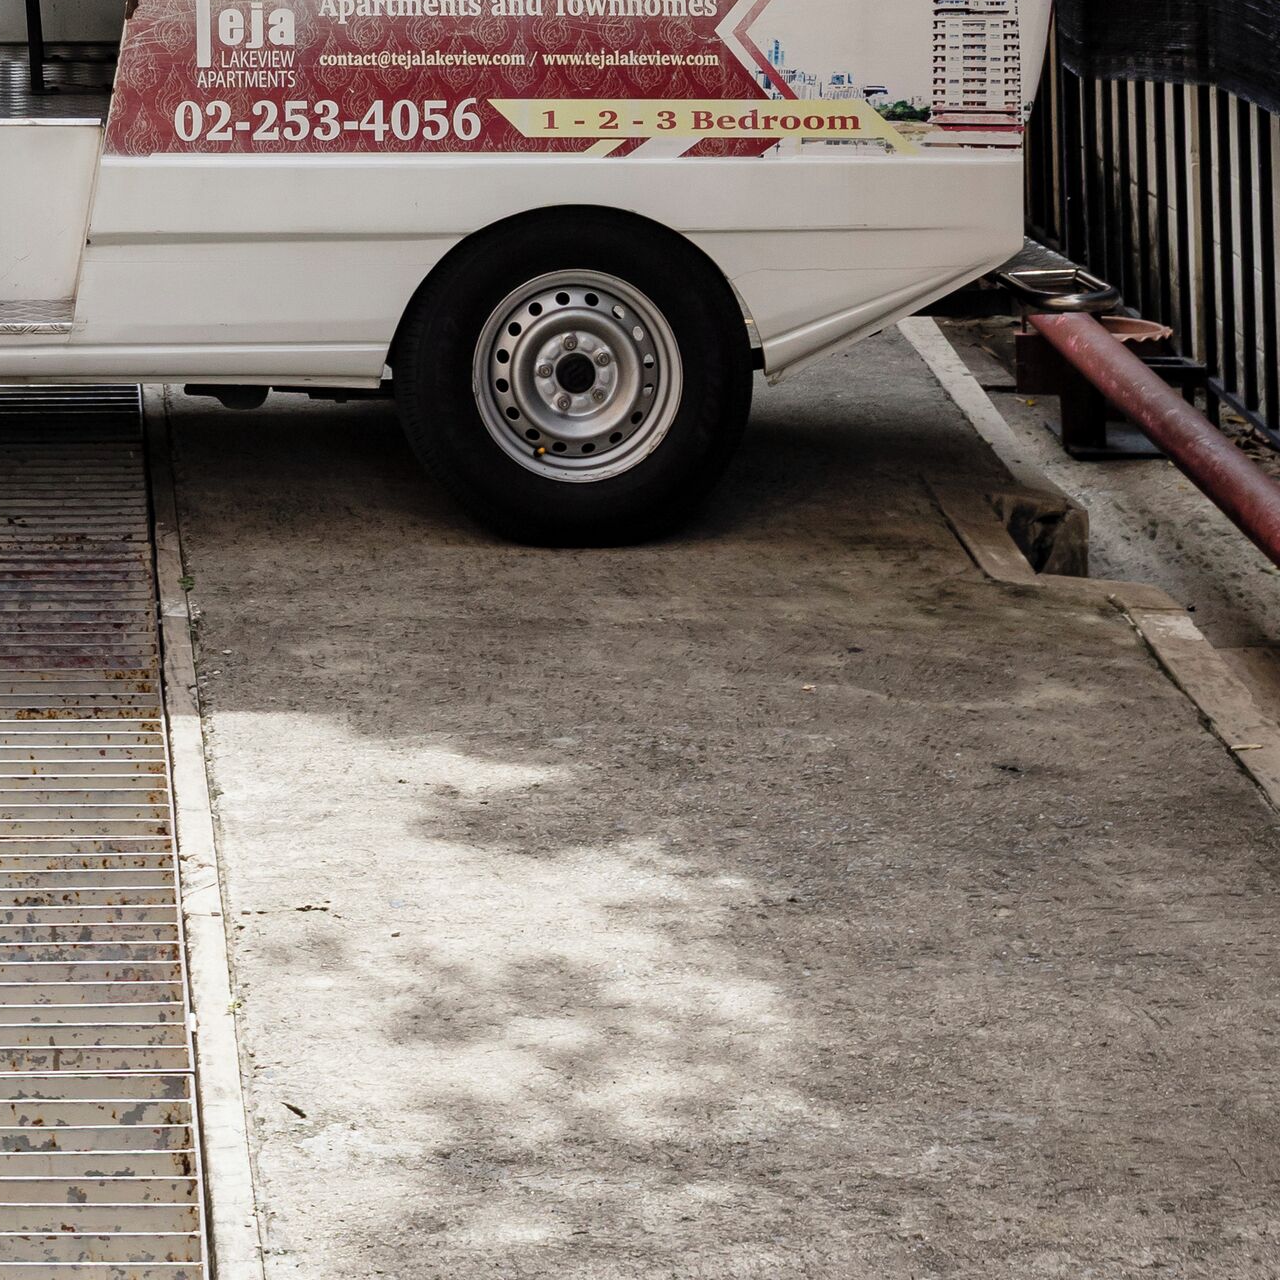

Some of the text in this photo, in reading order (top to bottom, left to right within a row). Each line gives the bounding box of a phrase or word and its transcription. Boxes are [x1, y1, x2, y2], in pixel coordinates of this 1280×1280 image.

[221, 51, 295, 68] LAKEVIEW
[320, 49, 525, 69] contact@tejalakeview.com
[542, 48, 719, 69] www.tejalakeview.com
[197, 70, 296, 88] APARTMENTS
[174, 98, 481, 141] 02-253-4056
[542, 110, 559, 130] 1
[598, 110, 619, 130] 2
[656, 110, 677, 130] 3
[690, 109, 861, 130] Bedroom
